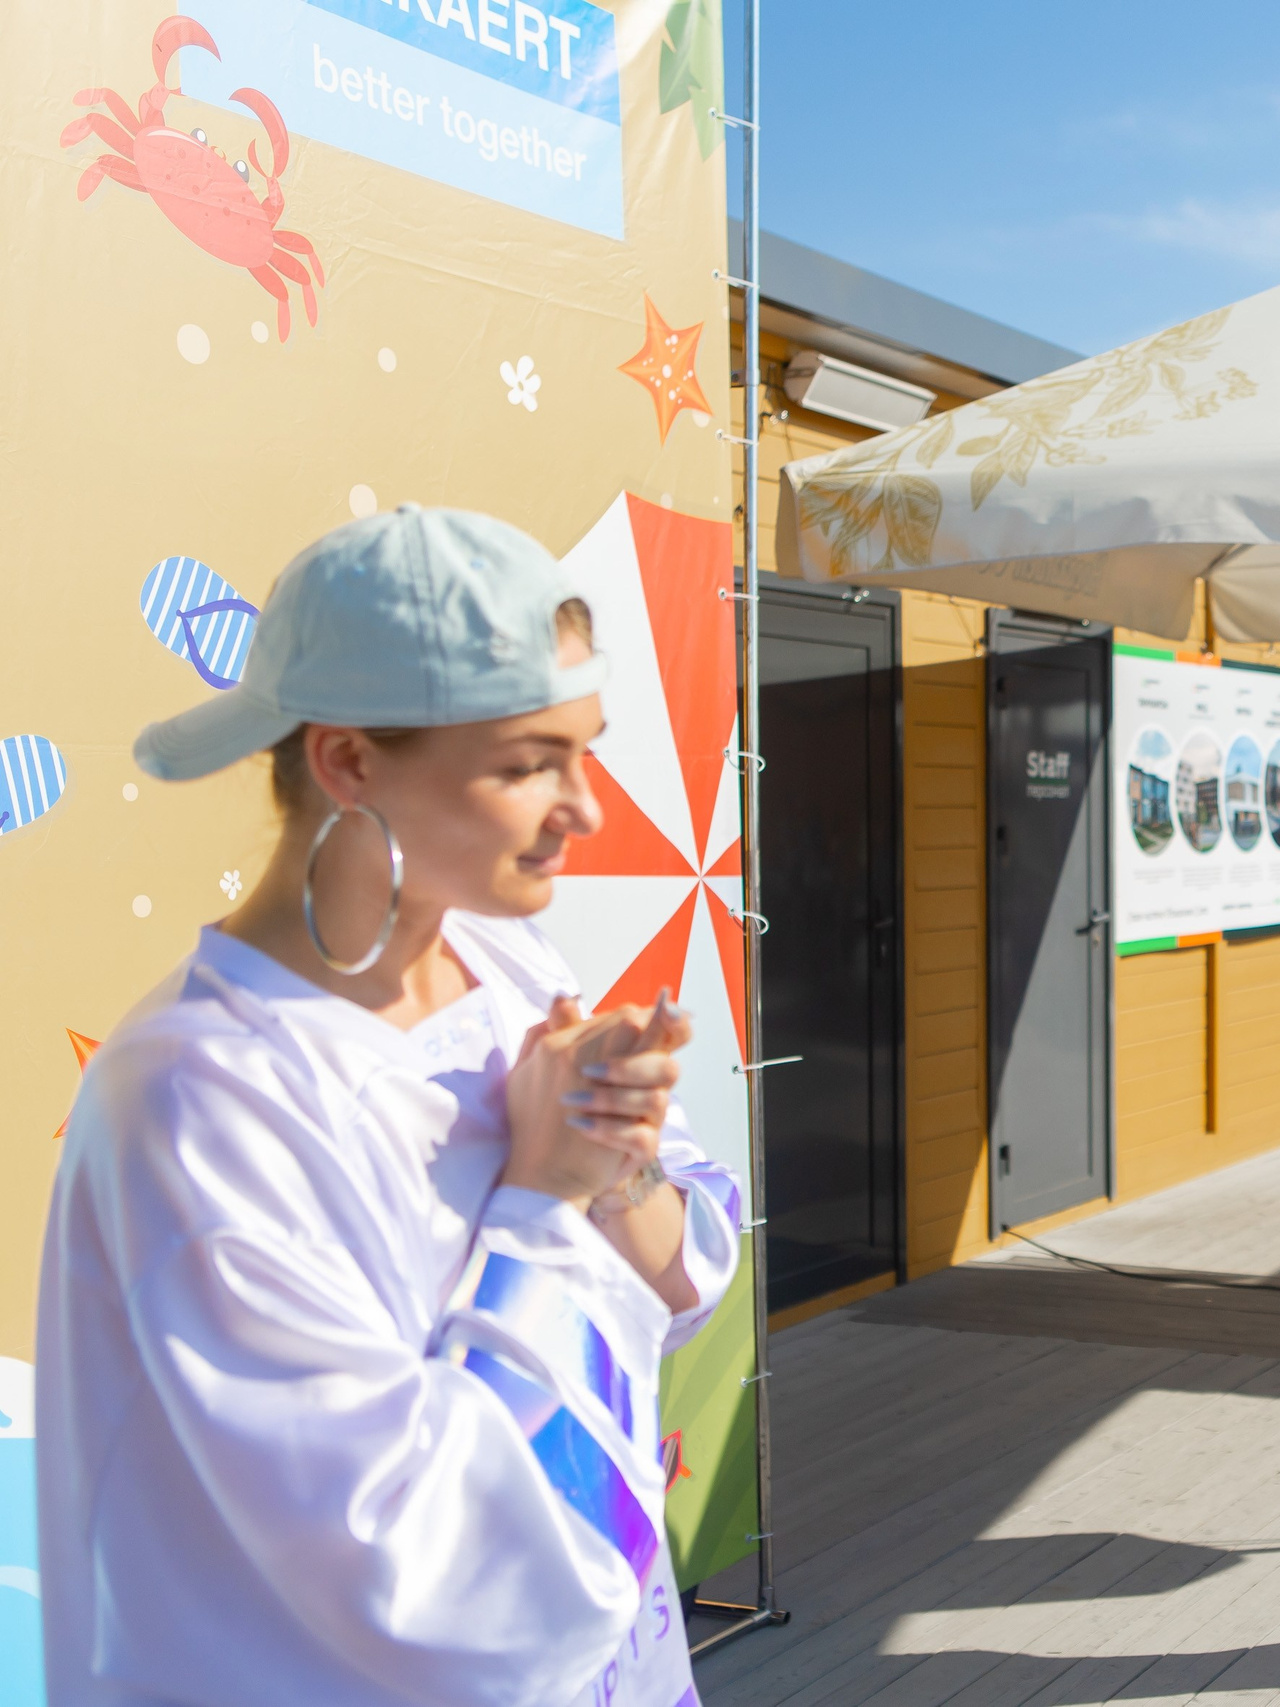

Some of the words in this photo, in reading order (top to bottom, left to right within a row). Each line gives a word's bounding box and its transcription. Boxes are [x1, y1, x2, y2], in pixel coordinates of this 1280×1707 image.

[380, 0, 581, 80] AERT
[312, 43, 430, 126] better
[439, 95, 588, 182] together
